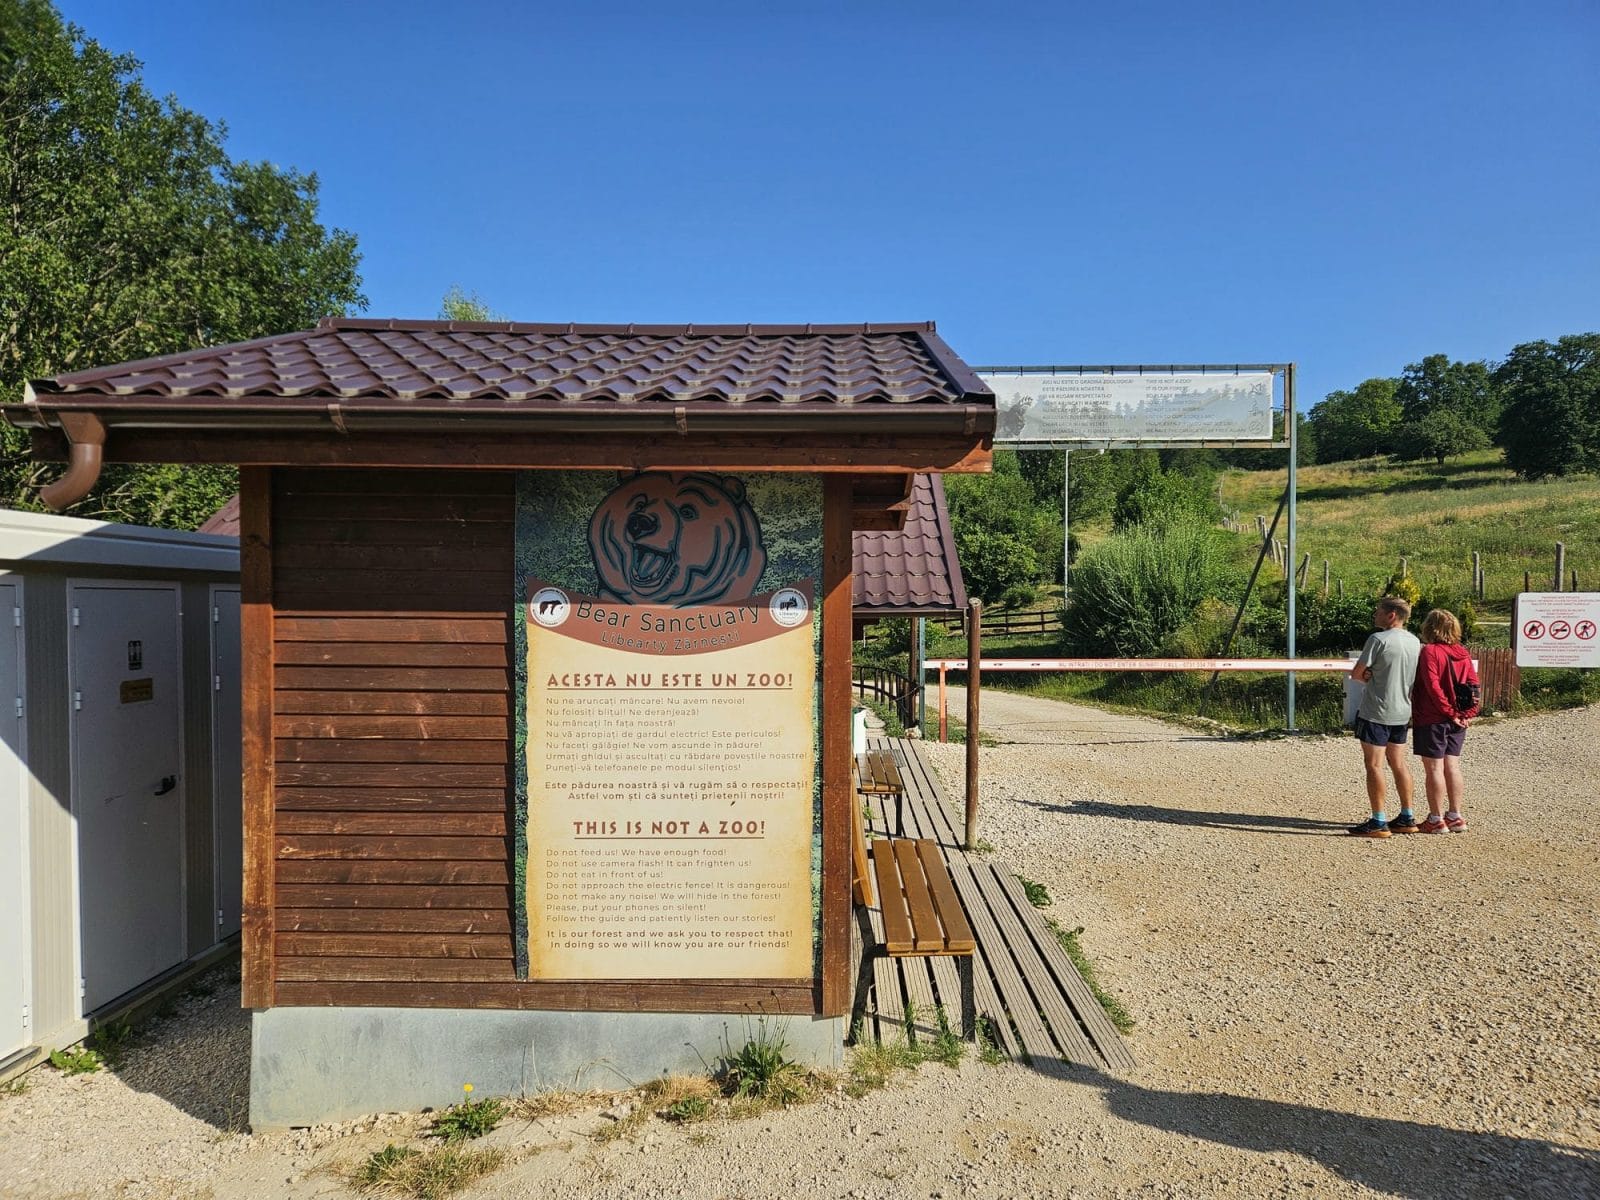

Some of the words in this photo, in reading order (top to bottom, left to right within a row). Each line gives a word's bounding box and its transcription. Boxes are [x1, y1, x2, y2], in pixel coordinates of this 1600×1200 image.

[576, 600, 630, 628] Bear
[640, 604, 759, 633] Sanctuary
[602, 631, 666, 652] Libearty
[547, 673, 617, 687] ACESTA
[626, 673, 652, 687] NU
[661, 673, 701, 687] ESTE
[712, 673, 737, 687] UN
[747, 673, 793, 687] ZOO!
[546, 697, 559, 705] Nu
[667, 697, 680, 705] Nu
[711, 697, 745, 705] nevoie!
[546, 708, 559, 716] Nu
[629, 708, 642, 716] Ne
[546, 719, 559, 727] Nu
[546, 730, 559, 738] Nu
[621, 730, 634, 738] de
[636, 730, 667, 739] gardul
[670, 730, 709, 738] electric!
[711, 730, 732, 738] Este
[735, 730, 781, 739] periculos!
[546, 741, 559, 749] Nu
[633, 741, 646, 749] Ne
[671, 741, 711, 749] ascunde
[581, 752, 612, 761] ghidul
[769, 752, 807, 760] noastre!
[594, 763, 647, 771] telefoanele
[651, 764, 662, 773] pe
[665, 763, 695, 771] modul
[545, 781, 568, 789] Este
[568, 792, 599, 800] Astfel
[701, 792, 747, 801] prietenii
[573, 821, 617, 835] THIS
[626, 821, 642, 835] IS
[651, 821, 690, 835] NOT
[698, 821, 710, 835] A
[719, 821, 765, 835] ZOO!
[546, 848, 559, 856] Do
[562, 848, 578, 856] not
[580, 848, 602, 856] feed
[604, 848, 618, 856] us!
[621, 848, 636, 856] We
[638, 848, 661, 856] have
[663, 848, 700, 858] enough
[702, 848, 726, 856] food!
[546, 859, 559, 867] Do
[562, 859, 578, 867] not
[638, 859, 664, 867] flash!
[666, 859, 673, 867] It
[696, 859, 735, 869] frighten
[738, 859, 751, 867] us!
[546, 870, 559, 878] Do
[562, 870, 578, 878] not
[581, 870, 596, 878] eat
[599, 870, 608, 878] in
[610, 870, 634, 878] front
[637, 870, 647, 878] of
[649, 870, 664, 878] us!
[546, 881, 559, 889] Do
[562, 881, 578, 889] not
[581, 881, 625, 891] approach
[627, 881, 644, 889] the
[646, 881, 682, 889] electric
[685, 881, 714, 889] fence!
[717, 881, 724, 889] It
[727, 881, 735, 889] is
[737, 881, 790, 891] dangerous!
[546, 892, 559, 900] Do
[562, 892, 578, 900] not
[581, 892, 607, 900] make
[610, 893, 626, 902] any
[629, 892, 656, 900] noise!
[660, 892, 675, 900] We
[677, 892, 694, 900] will
[697, 892, 718, 900] hide
[721, 892, 729, 900] in
[732, 892, 748, 900] the
[751, 892, 780, 900] forest!
[546, 903, 579, 913] Please,
[582, 903, 598, 913] put
[601, 904, 622, 913] your
[625, 903, 660, 913] phones
[676, 903, 706, 911] silent!
[546, 914, 577, 922] Follow
[579, 914, 596, 922] the
[598, 914, 625, 923] guide
[628, 914, 646, 922] and
[649, 914, 691, 923] patiently
[694, 914, 720, 922] listen
[742, 914, 775, 922] stories!
[547, 930, 555, 938] It
[558, 930, 567, 938] is
[591, 930, 623, 938] forest
[626, 930, 646, 938] and
[667, 930, 685, 938] ask
[688, 931, 707, 939] you
[710, 930, 722, 938] to
[725, 930, 764, 939] respect
[767, 930, 793, 938] that!
[551, 940, 560, 948] In
[564, 940, 594, 950] doing
[631, 940, 650, 948] will
[654, 940, 682, 948] know
[684, 942, 704, 950] you
[749, 940, 789, 948] friends!
